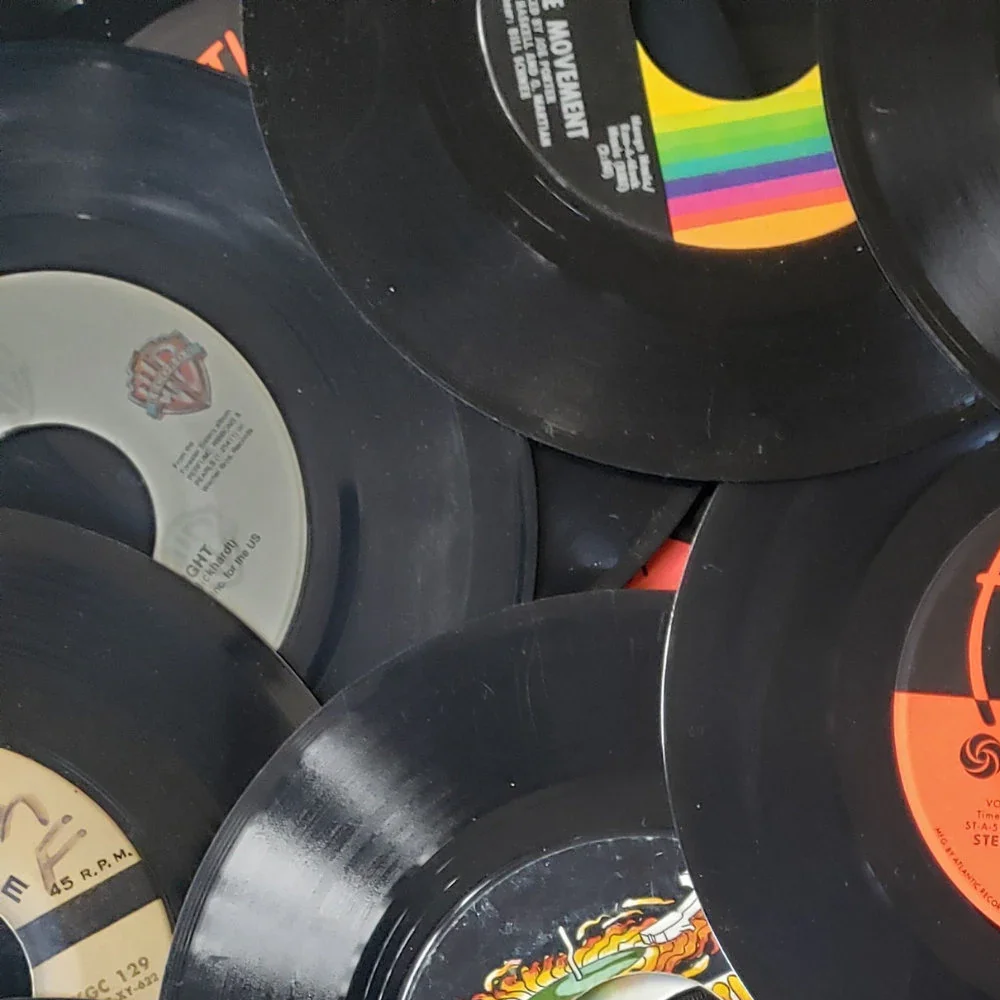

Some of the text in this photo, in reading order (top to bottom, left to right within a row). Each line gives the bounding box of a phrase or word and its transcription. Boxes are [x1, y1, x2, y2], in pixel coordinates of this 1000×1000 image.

[546, 20, 589, 139] MOVEMENT
[247, 532, 262, 550] US
[50, 848, 133, 896] 45 R.P.M.
[952, 856, 981, 891] ATLANTIC
[116, 956, 150, 984] 129
